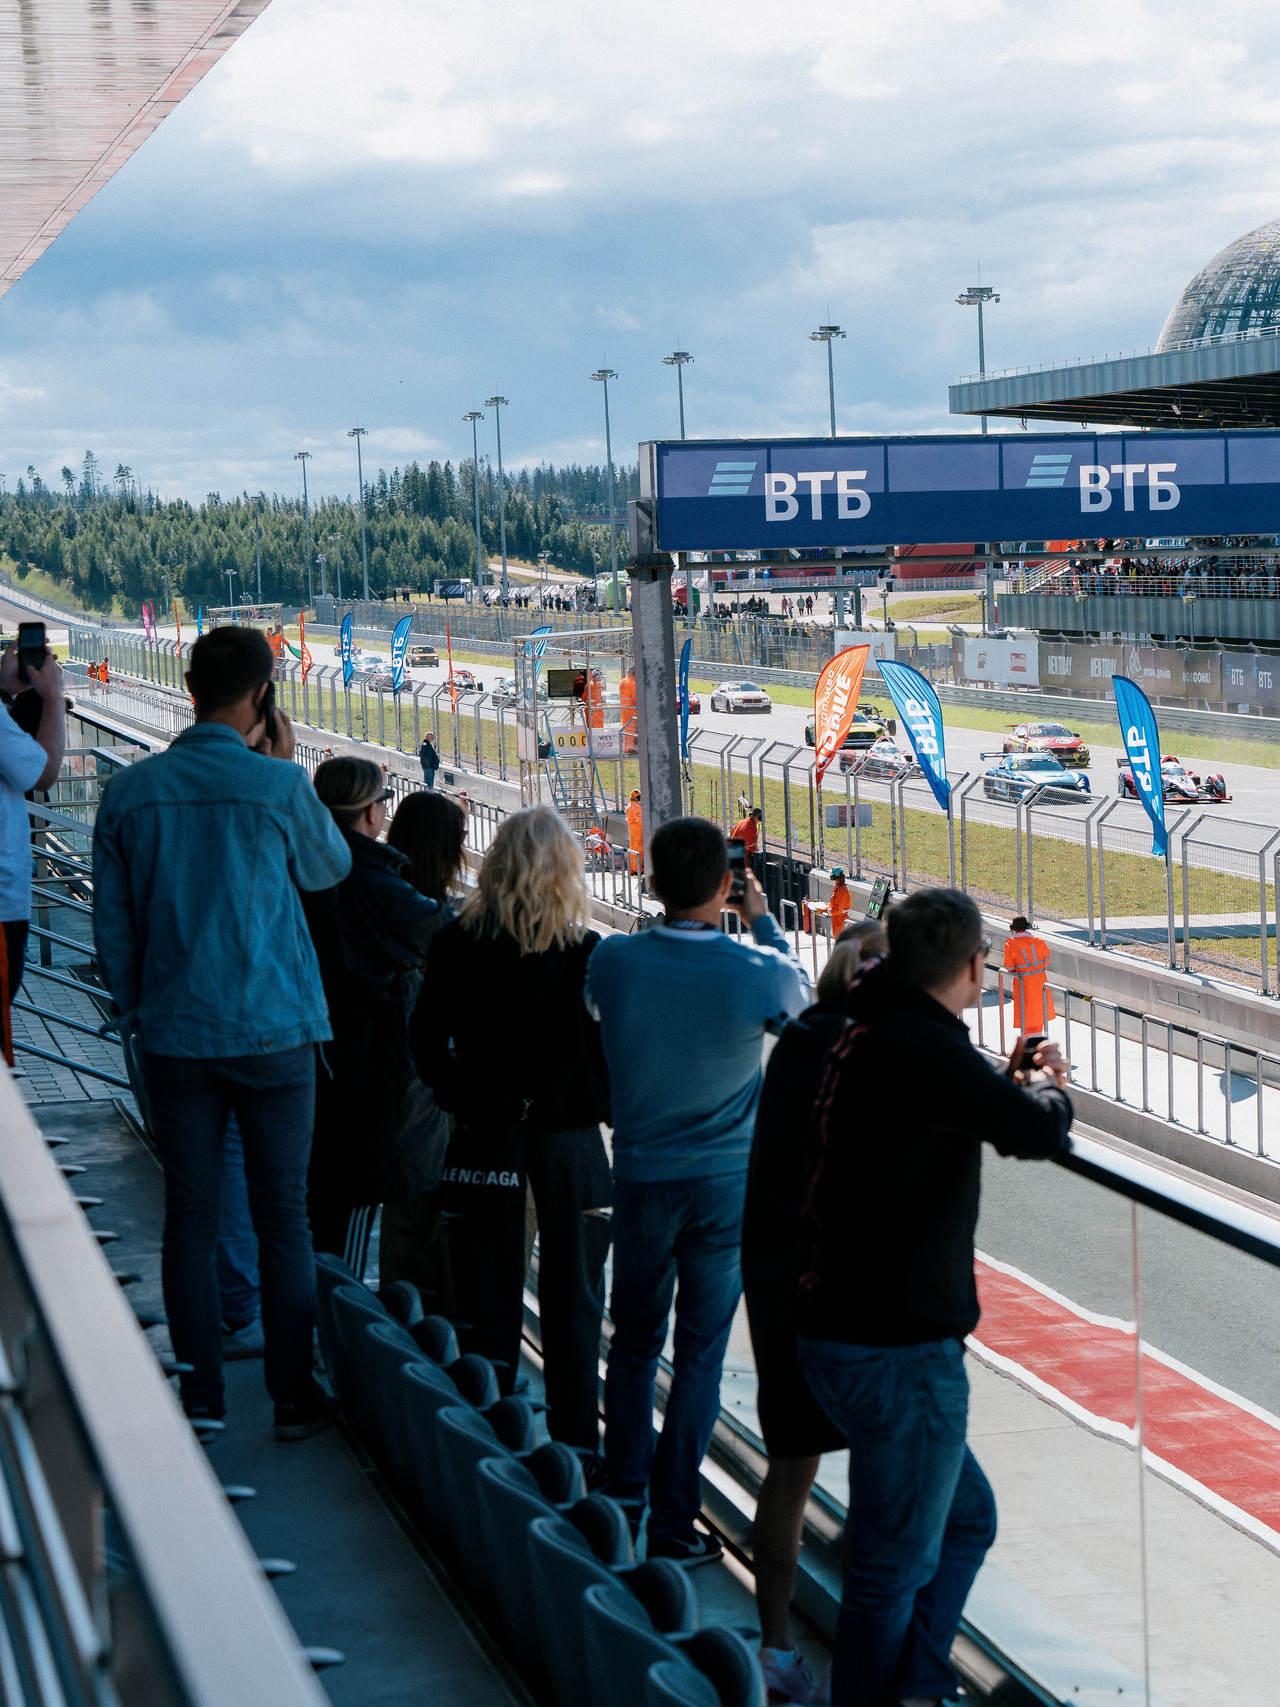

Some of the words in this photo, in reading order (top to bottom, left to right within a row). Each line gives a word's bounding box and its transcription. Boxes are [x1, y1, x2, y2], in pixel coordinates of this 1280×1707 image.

[764, 470, 871, 522] ВТБ
[1079, 463, 1181, 513] ВТБ
[1231, 668, 1244, 686] ВТБ
[1258, 671, 1272, 689] ВТБ
